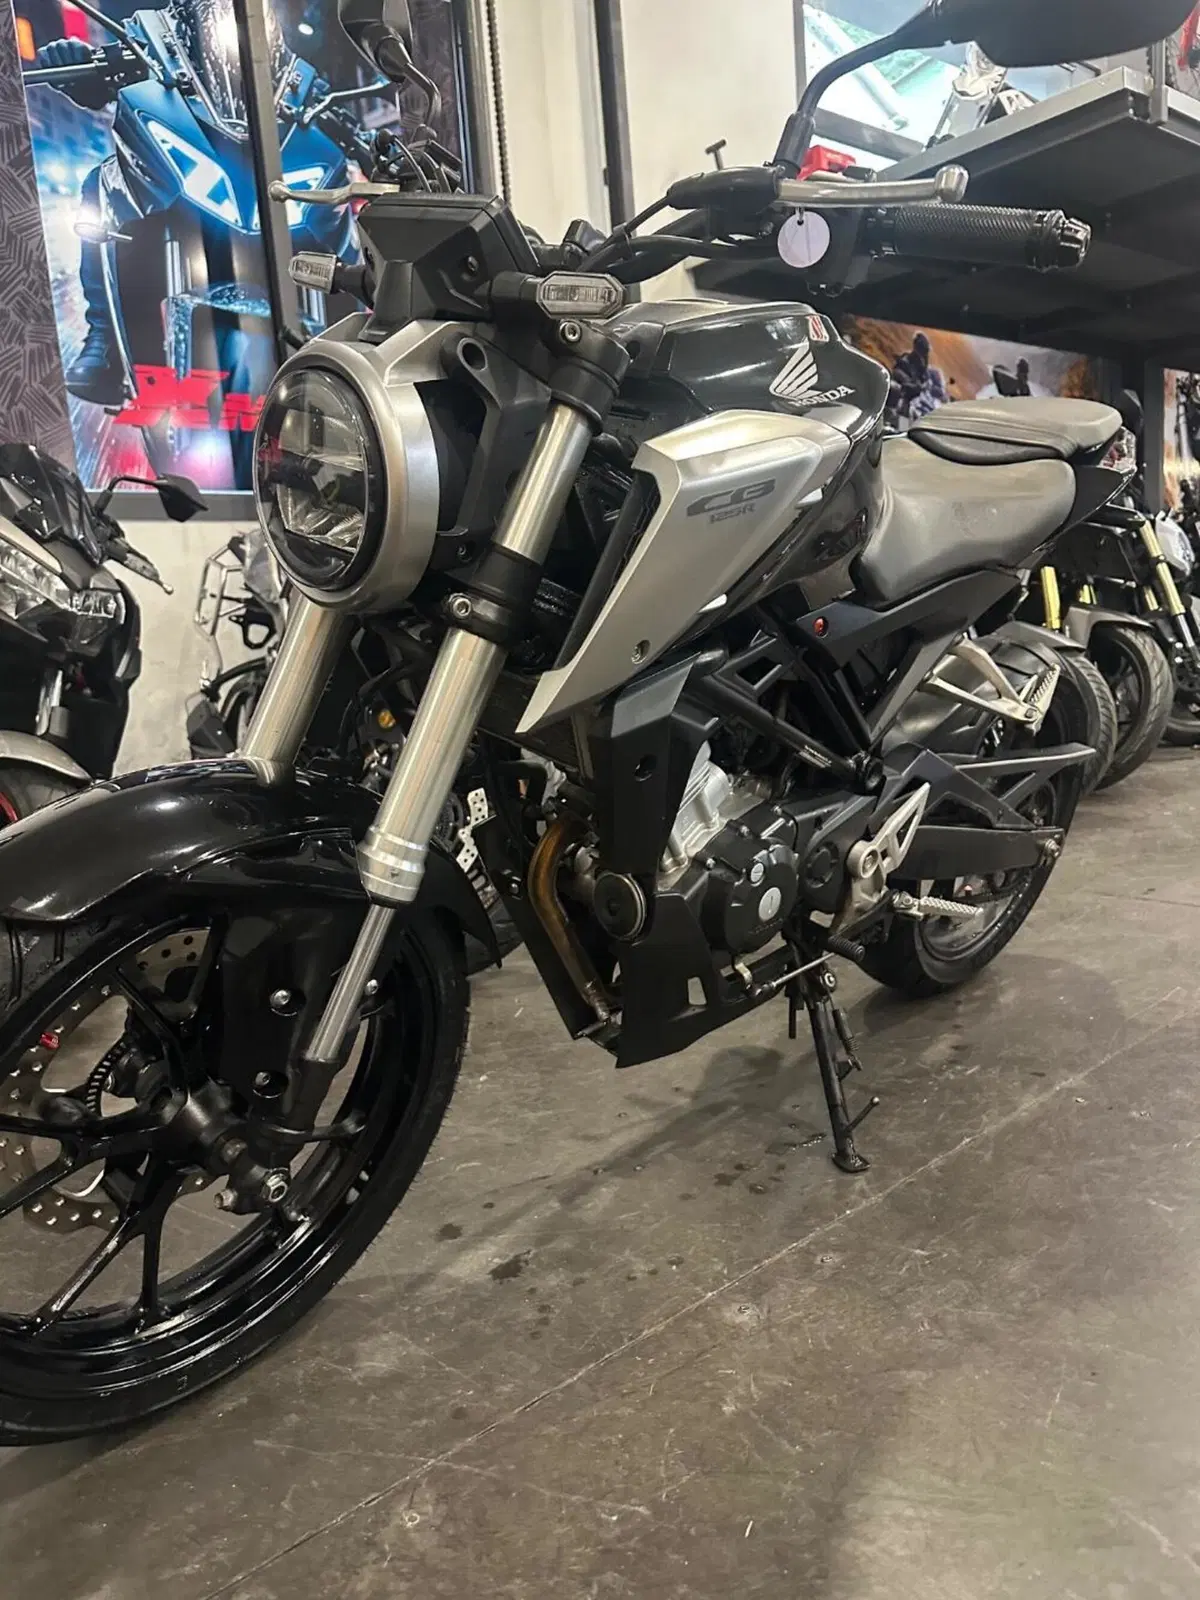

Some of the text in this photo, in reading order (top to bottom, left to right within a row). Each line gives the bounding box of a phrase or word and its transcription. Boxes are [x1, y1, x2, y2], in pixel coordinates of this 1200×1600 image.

[788, 385, 856, 407] HONDA
[687, 478, 777, 517] CB
[710, 502, 756, 524] 125R
